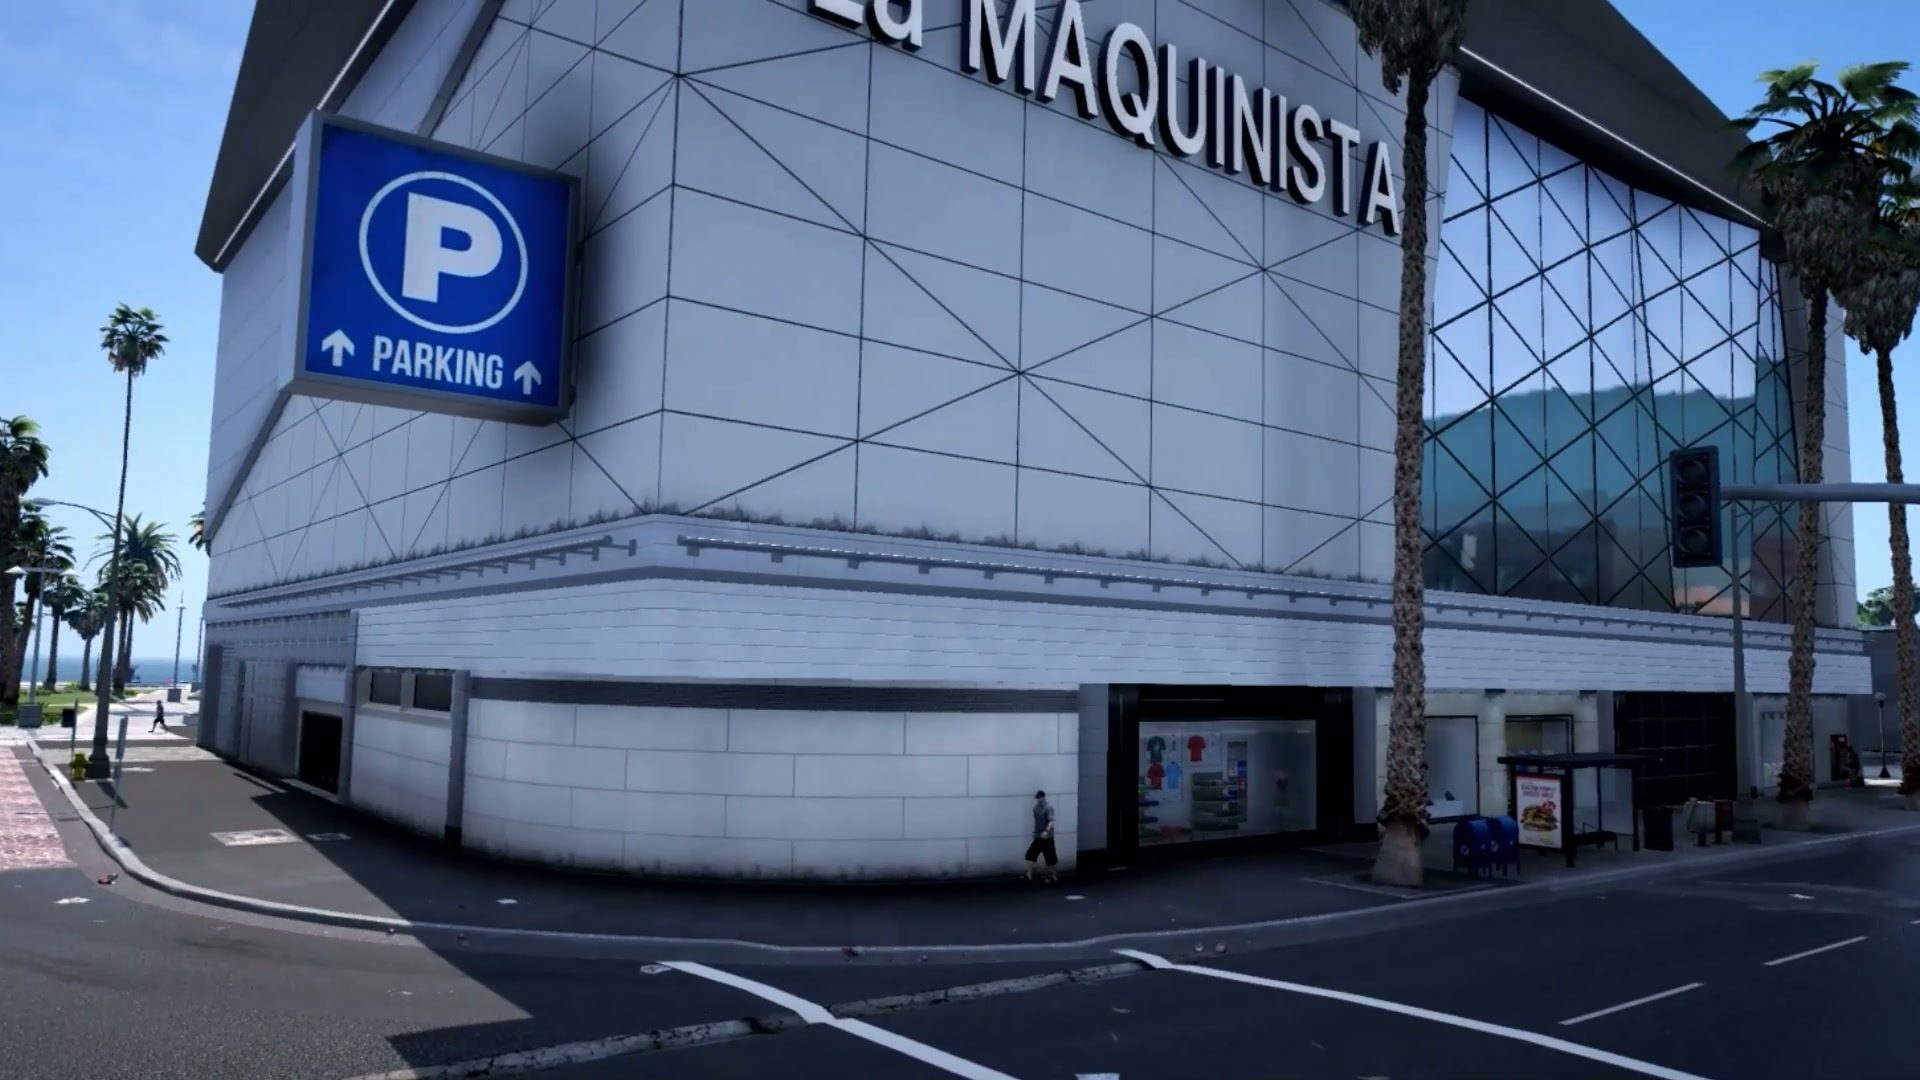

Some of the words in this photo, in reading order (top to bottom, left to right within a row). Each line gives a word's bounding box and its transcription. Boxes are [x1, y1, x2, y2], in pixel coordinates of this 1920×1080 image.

[962, 0, 1401, 236] MAQUINISTA
[402, 192, 502, 303] P
[372, 335, 504, 389] PARKING
